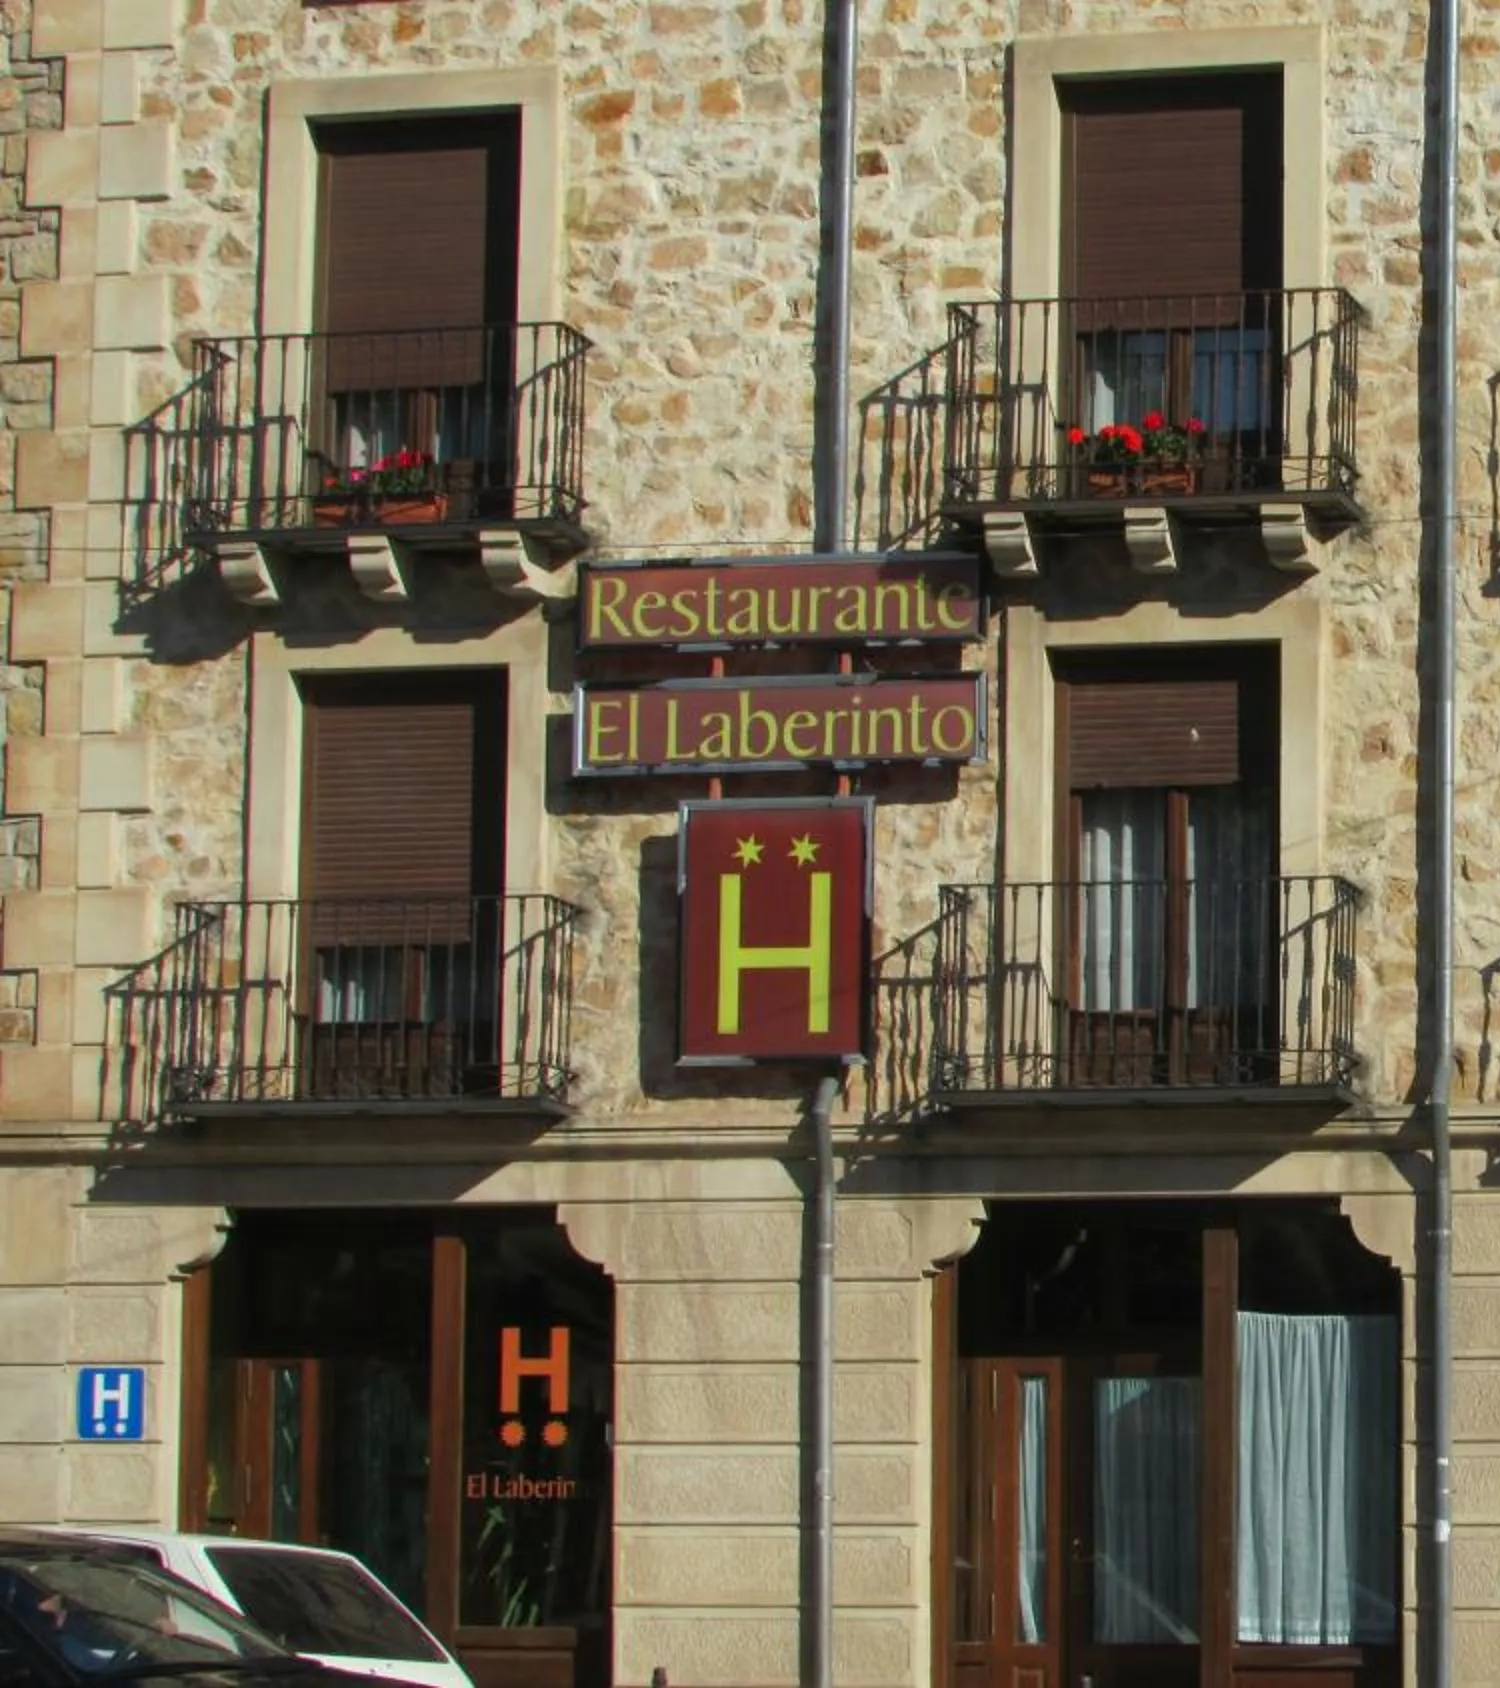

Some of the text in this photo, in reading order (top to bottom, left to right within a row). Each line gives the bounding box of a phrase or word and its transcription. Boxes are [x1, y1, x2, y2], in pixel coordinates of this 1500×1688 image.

[588, 574, 974, 640] Restaurante
[587, 690, 976, 762] El Laberinto
[717, 871, 832, 1035] H
[92, 1373, 130, 1420] H
[500, 1327, 570, 1414] H
[466, 1471, 488, 1499] El
